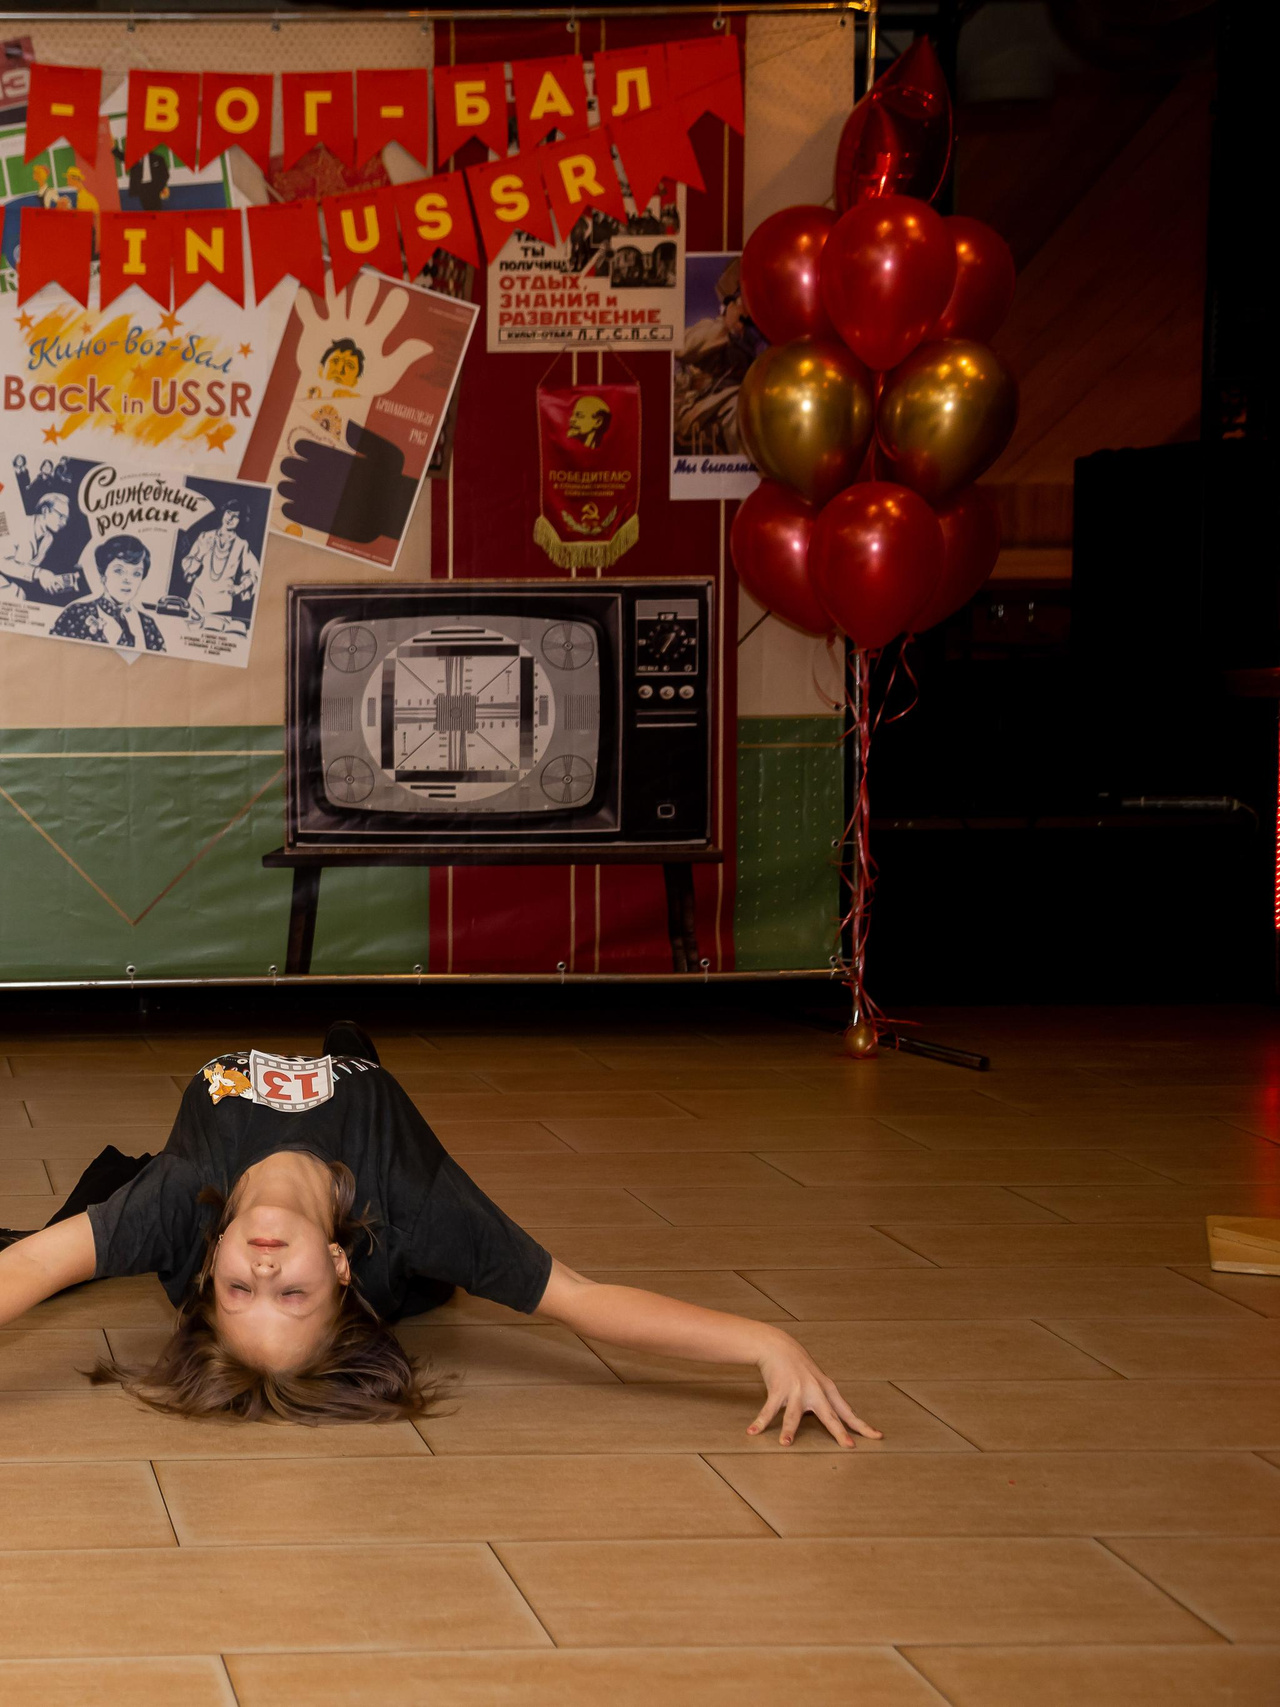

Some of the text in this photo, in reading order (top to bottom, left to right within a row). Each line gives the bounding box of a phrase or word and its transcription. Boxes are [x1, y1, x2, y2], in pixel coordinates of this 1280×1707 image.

[123, 228, 225, 274] IN
[341, 155, 605, 253] USSR
[500, 292, 600, 309] ЗНАНИЯ
[499, 309, 661, 327] РАЗВЛЕЧЕНИЕ
[4, 375, 253, 418] Back in USSR
[83, 464, 208, 514] Служебный
[95, 505, 181, 537] роман
[262, 1070, 320, 1102] 13
